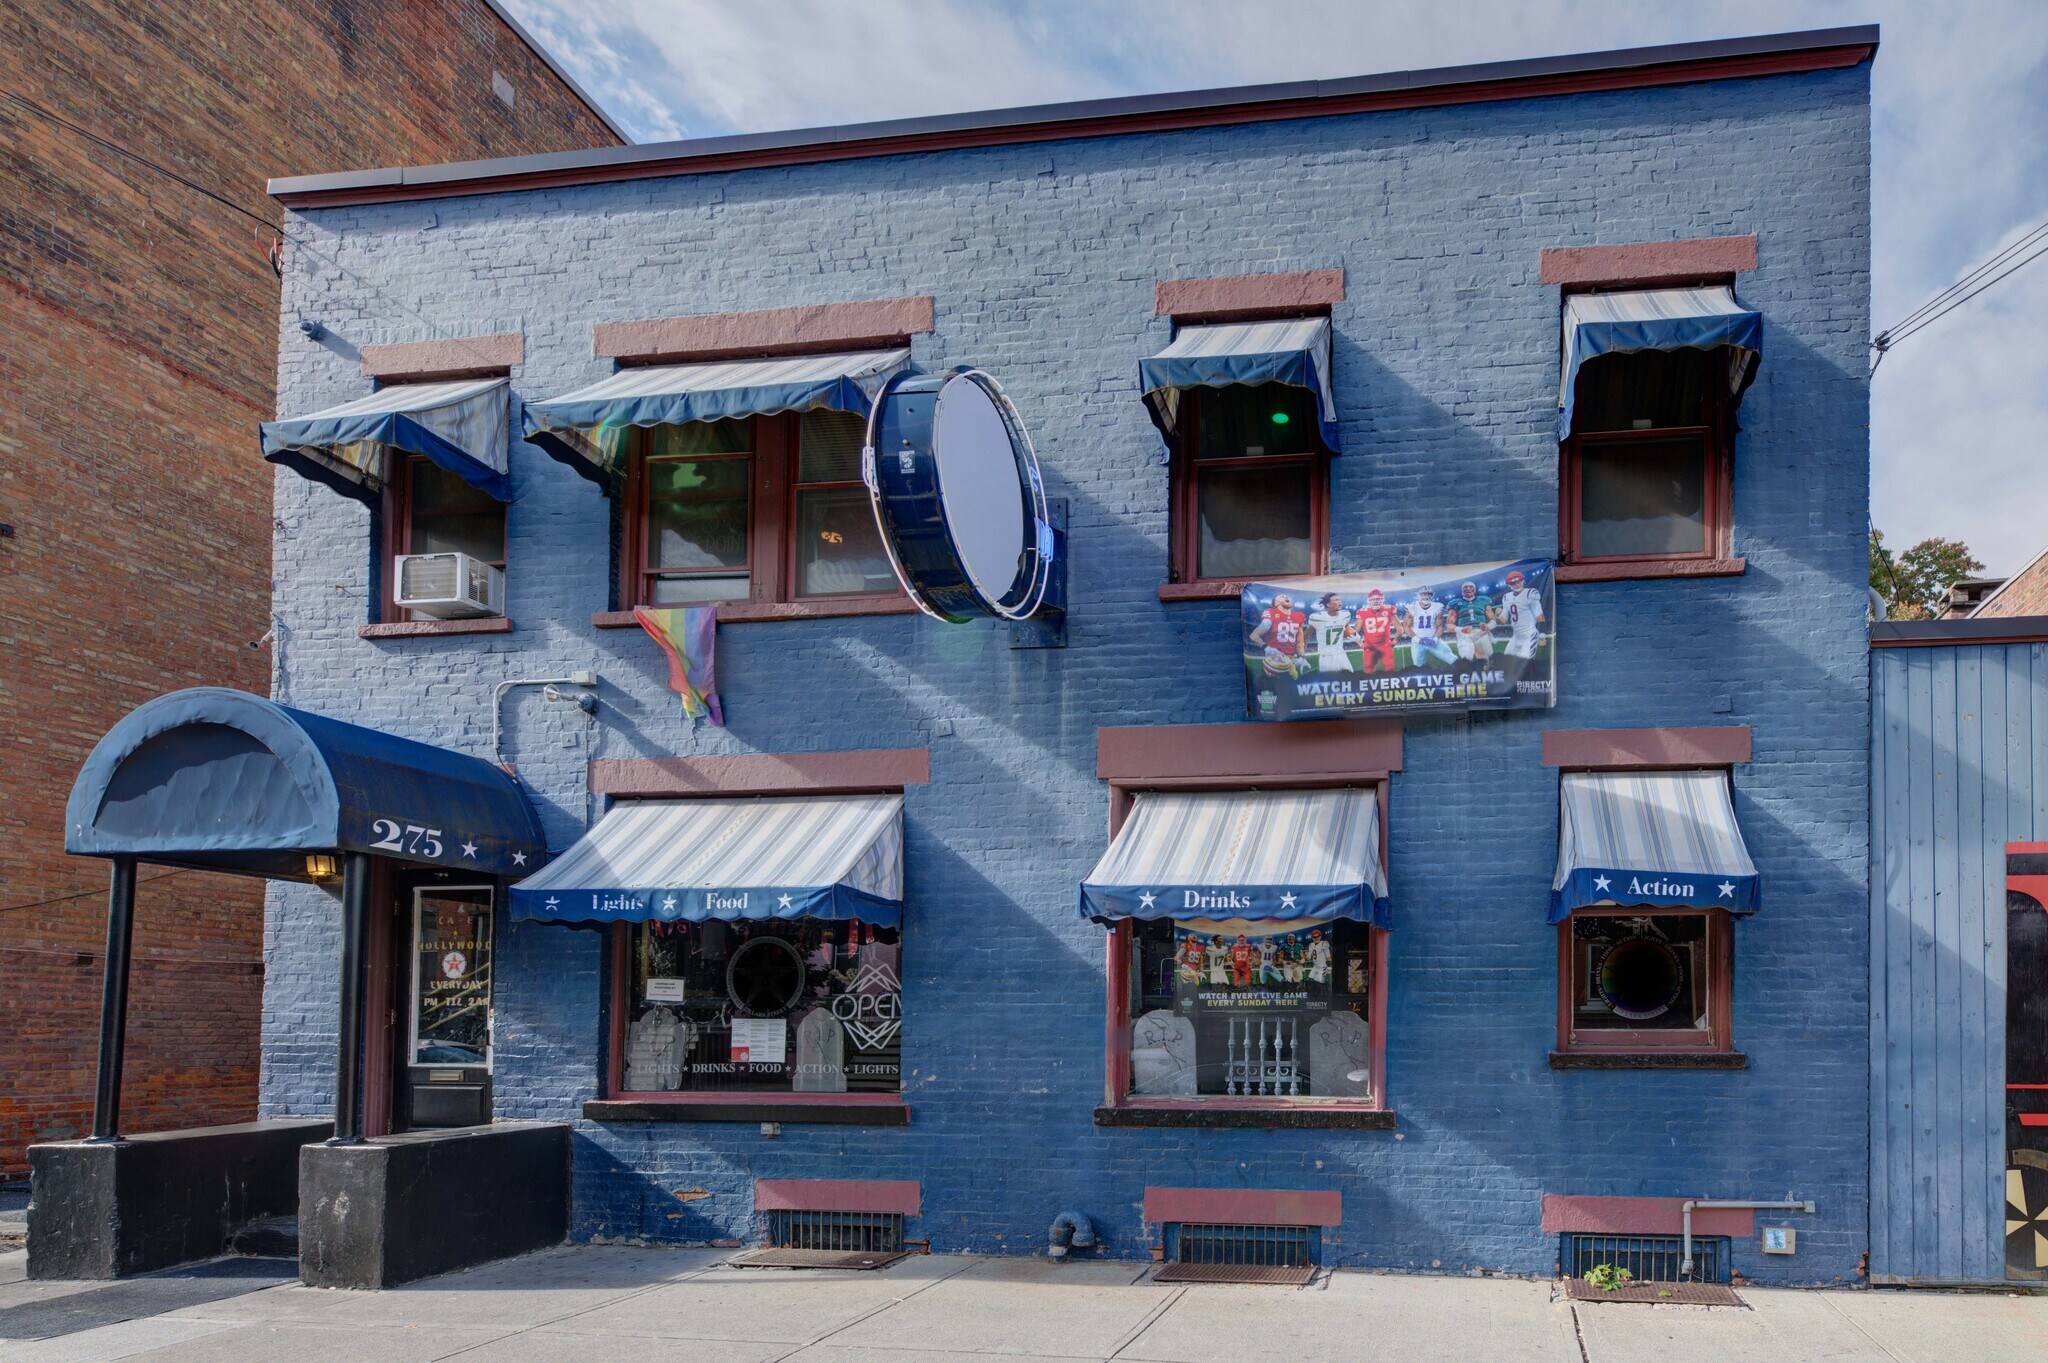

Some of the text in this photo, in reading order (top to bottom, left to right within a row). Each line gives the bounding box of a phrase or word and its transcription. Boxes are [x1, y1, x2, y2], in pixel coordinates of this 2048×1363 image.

[1365, 617, 1388, 633] 87
[1418, 615, 1431, 629] 11
[1277, 622, 1299, 643] 85
[1325, 627, 1344, 645] 17
[1297, 671, 1505, 696] WATCH EVERY LIVE GAME
[1315, 683, 1487, 707] EVERY SUNDAY HERE
[370, 819, 443, 858] 275
[1628, 876, 1694, 897] Action
[592, 893, 748, 912] Lights Food
[1184, 890, 1250, 909] Drinks
[439, 916, 472, 925] CAE
[637, 1063, 899, 1074] LIGHTS DRINKS FOOD ACTION LIGHTS
